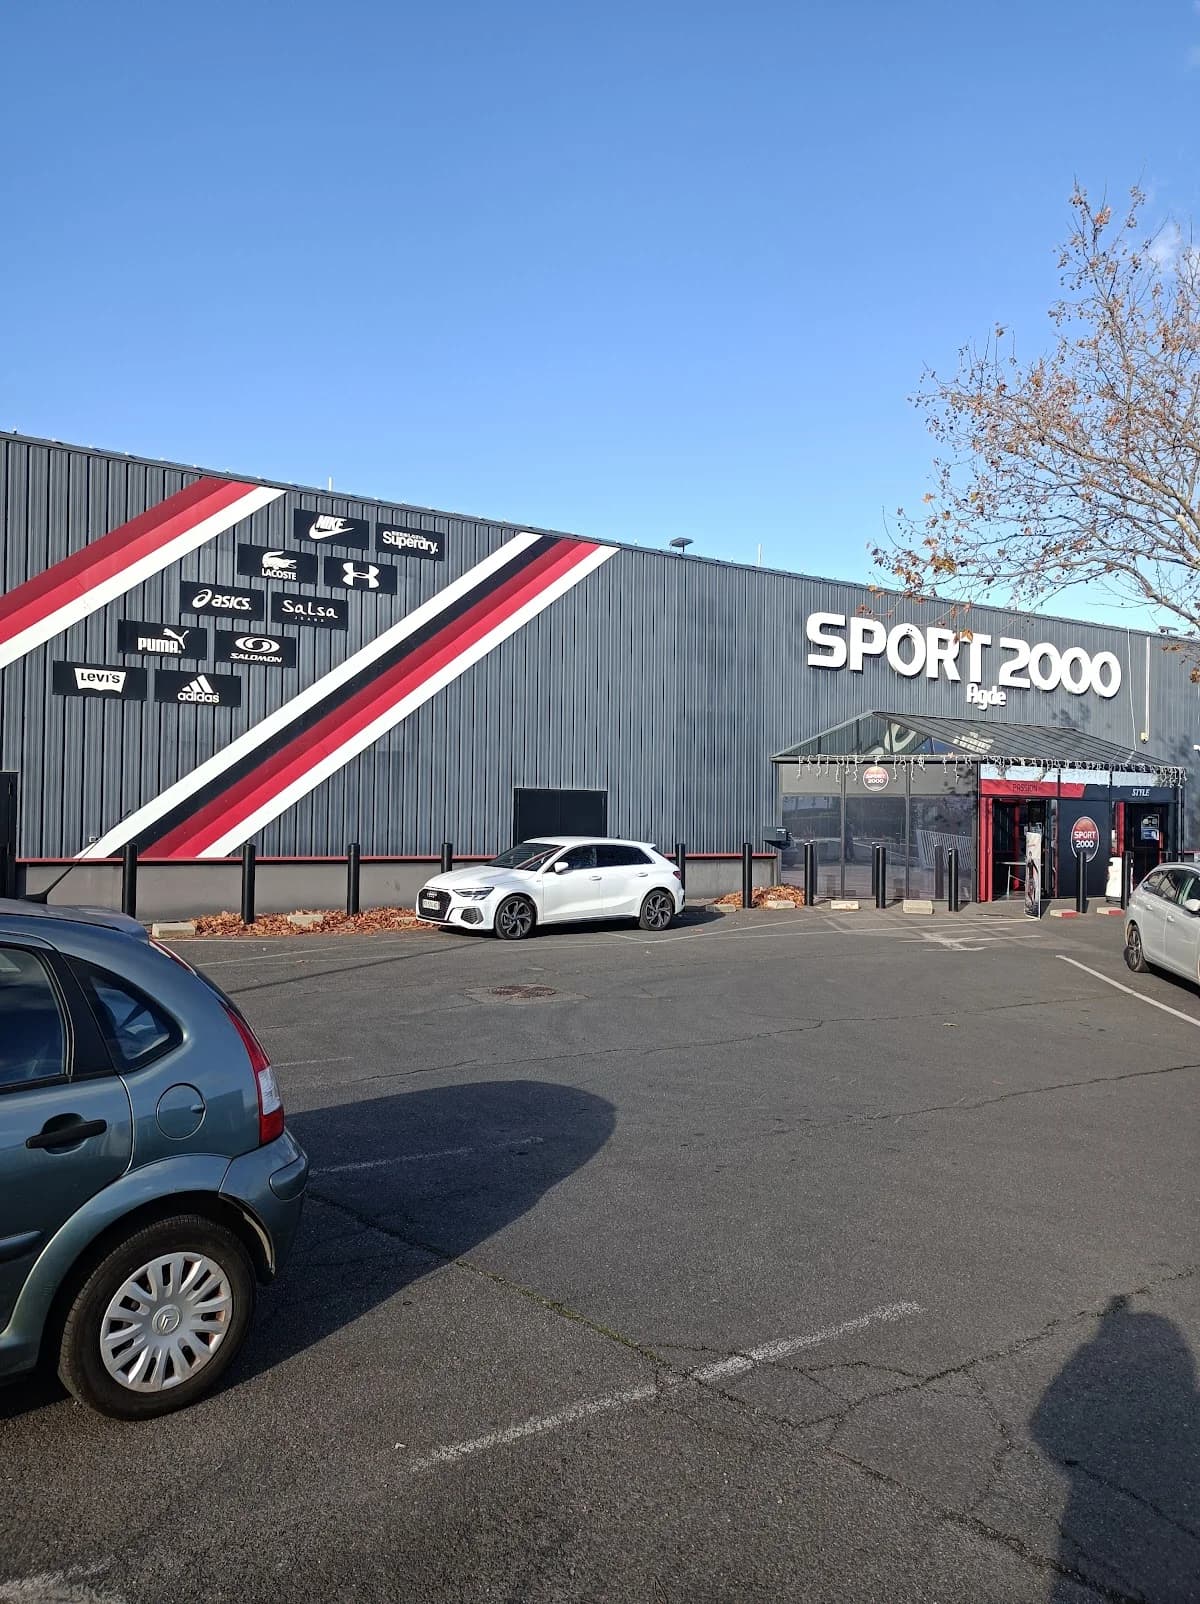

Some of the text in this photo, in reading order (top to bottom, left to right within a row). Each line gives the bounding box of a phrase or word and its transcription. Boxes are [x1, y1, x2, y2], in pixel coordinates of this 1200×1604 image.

[315, 514, 347, 531] NIKE
[261, 567, 297, 581] LACOSTE
[281, 600, 338, 619] Salsa
[229, 652, 282, 663] SALOMON
[806, 612, 1122, 699] SPORT 2000
[177, 691, 220, 703] adidas
[966, 683, 1007, 711] Agde
[1012, 783, 1039, 793] PASSION
[1132, 788, 1151, 797] STYLE
[1074, 831, 1097, 839] SPORT
[1075, 840, 1095, 849] 2000
